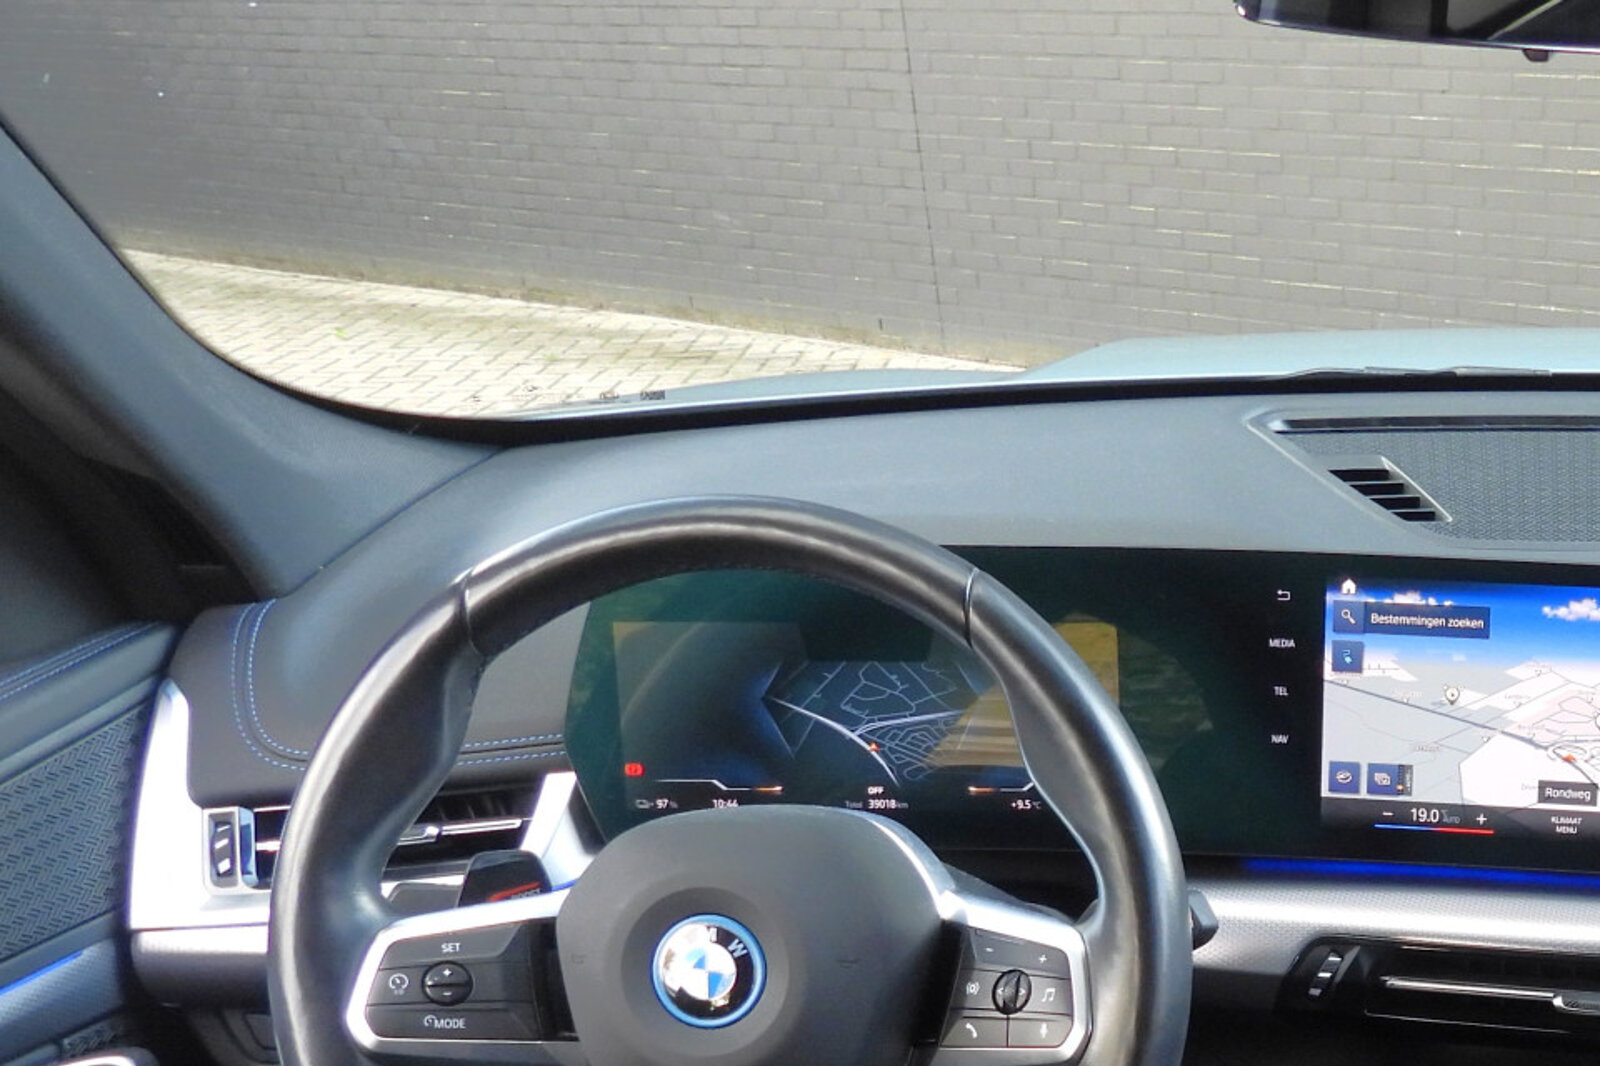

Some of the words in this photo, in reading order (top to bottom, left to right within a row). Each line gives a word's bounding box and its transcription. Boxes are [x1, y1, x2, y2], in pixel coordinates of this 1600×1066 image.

[1371, 613, 1445, 629] Bestemmingen
[1447, 619, 1484, 629] zoeken
[1269, 639, 1295, 648] MEDIA
[1274, 686, 1288, 696] TEL
[1271, 734, 1289, 744] NAV
[867, 786, 884, 794] OFF
[1544, 787, 1591, 801] Rondweg
[656, 800, 669, 808] 97
[713, 800, 739, 808] 10:44
[1411, 808, 1440, 823] 19.0
[1551, 816, 1582, 825] KLIMAAT
[1556, 825, 1577, 834] MENU
[441, 942, 461, 953] SET
[434, 1018, 466, 1029] MODE
